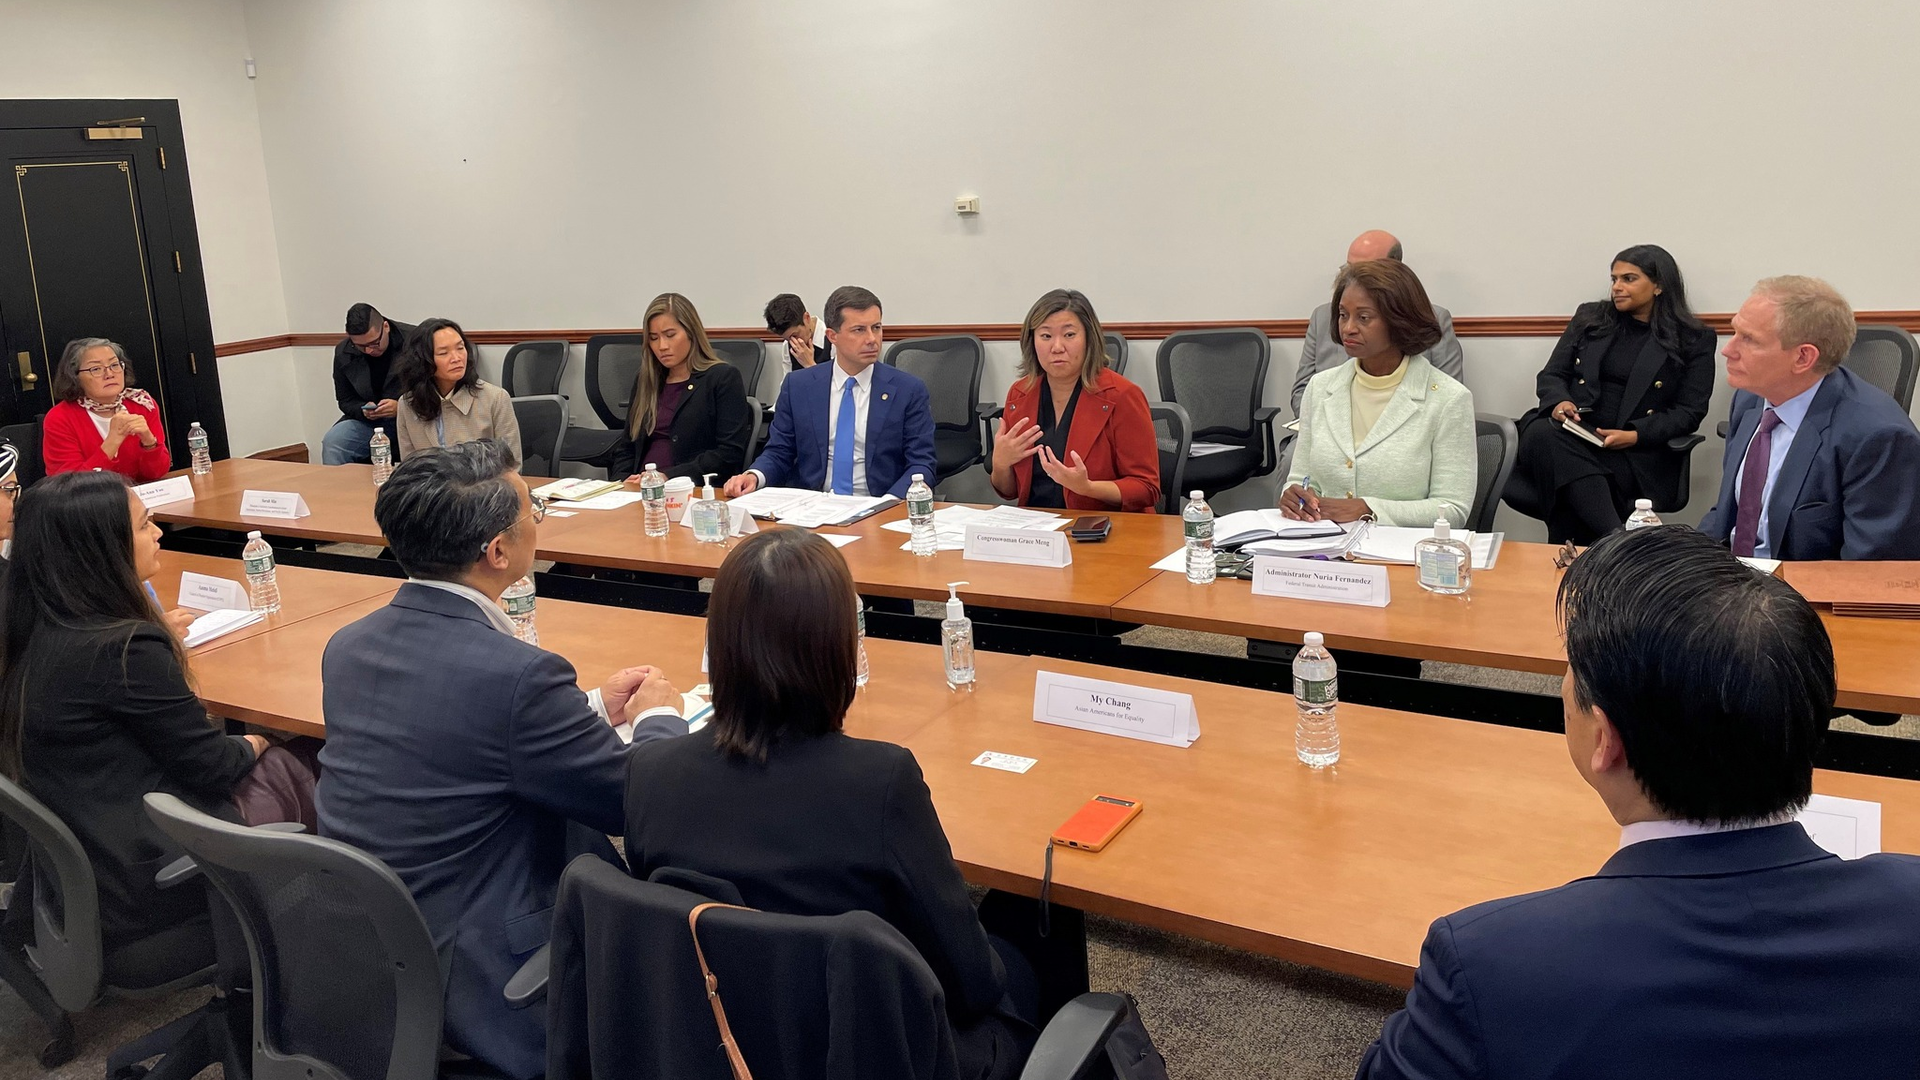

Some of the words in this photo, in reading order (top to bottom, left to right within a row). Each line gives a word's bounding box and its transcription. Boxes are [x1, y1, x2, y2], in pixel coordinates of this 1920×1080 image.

[976, 534, 1018, 544] Congresswoman
[1018, 537, 1034, 545] Grace
[1035, 539, 1050, 547] Meng
[1265, 568, 1312, 579] Administrator
[1313, 573, 1333, 581] Nuria
[1335, 575, 1372, 585] Fernandez
[1317, 583, 1348, 591] Administration
[1090, 694, 1103, 706] My
[1105, 697, 1132, 710] Chang
[1074, 705, 1089, 713] Asian
[1089, 707, 1116, 718] Americans
[1116, 711, 1124, 719] for
[1124, 713, 1145, 724] Equality
